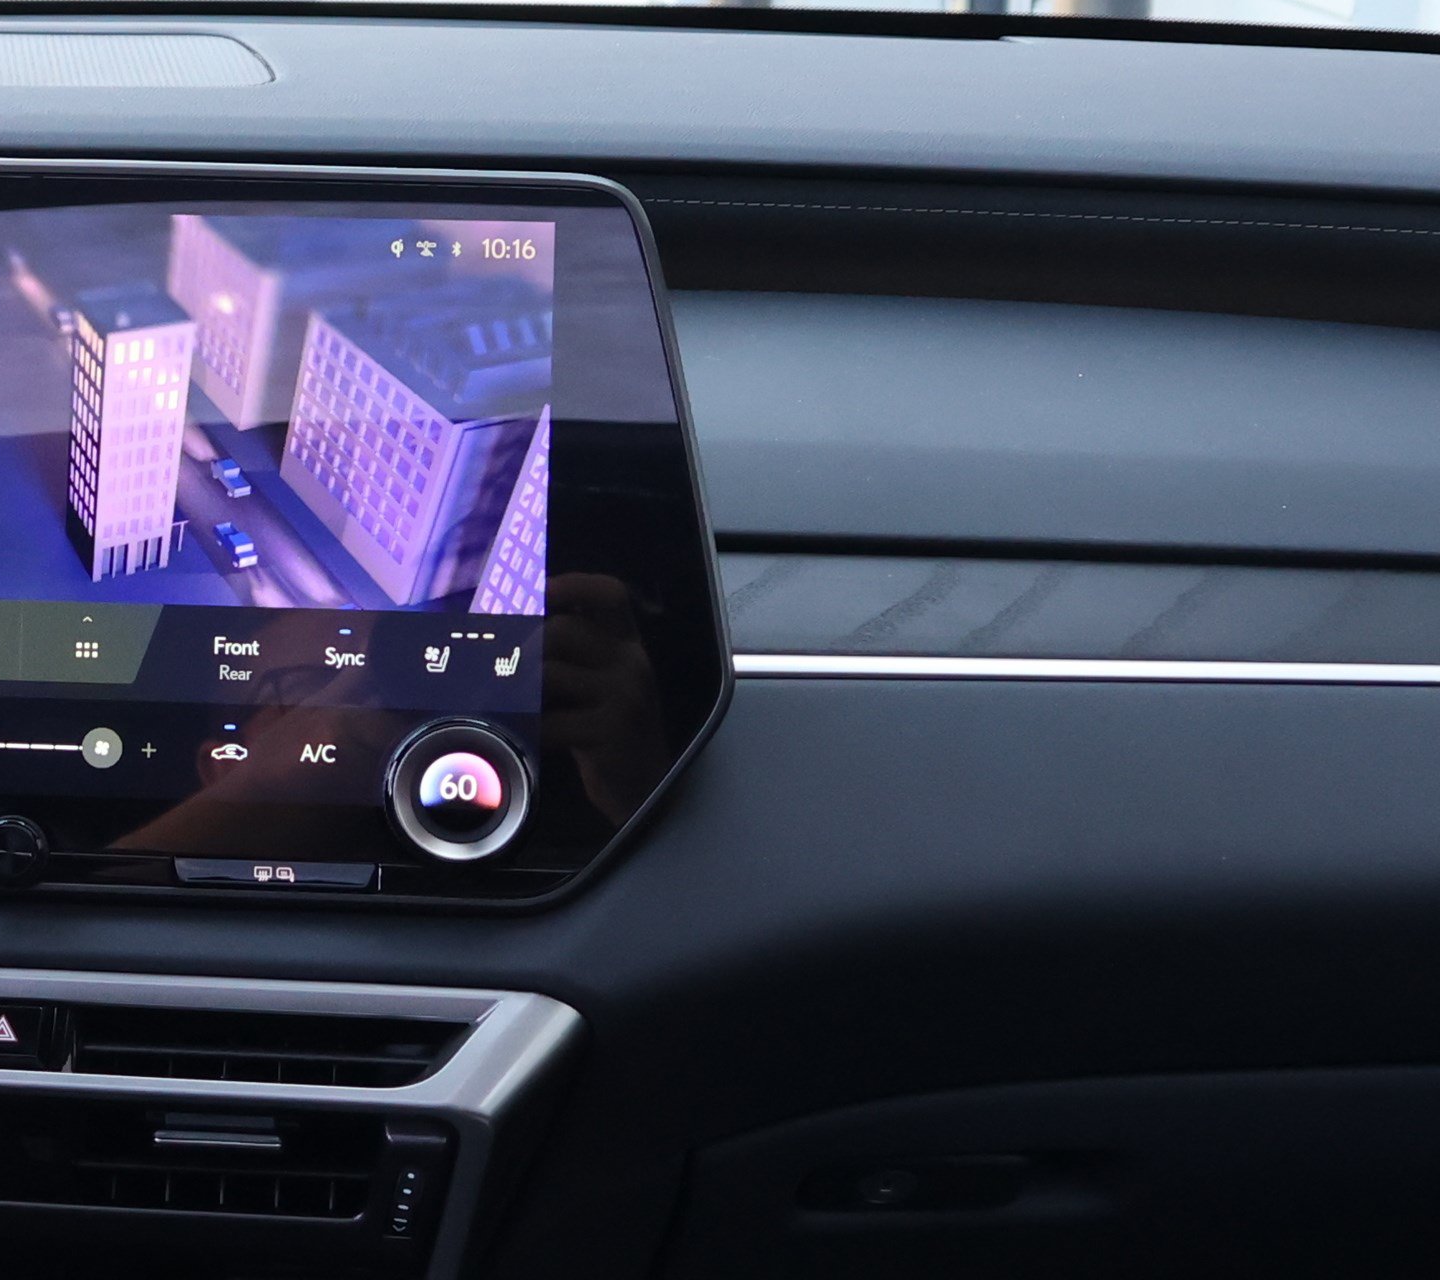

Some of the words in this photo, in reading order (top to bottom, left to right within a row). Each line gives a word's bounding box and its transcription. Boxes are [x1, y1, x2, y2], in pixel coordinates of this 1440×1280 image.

[481, 238, 537, 261] 10:16
[213, 636, 260, 657] Front
[324, 646, 366, 668] Sync
[219, 665, 253, 681] Rear
[300, 743, 337, 765] A/C
[439, 775, 478, 801] 60
